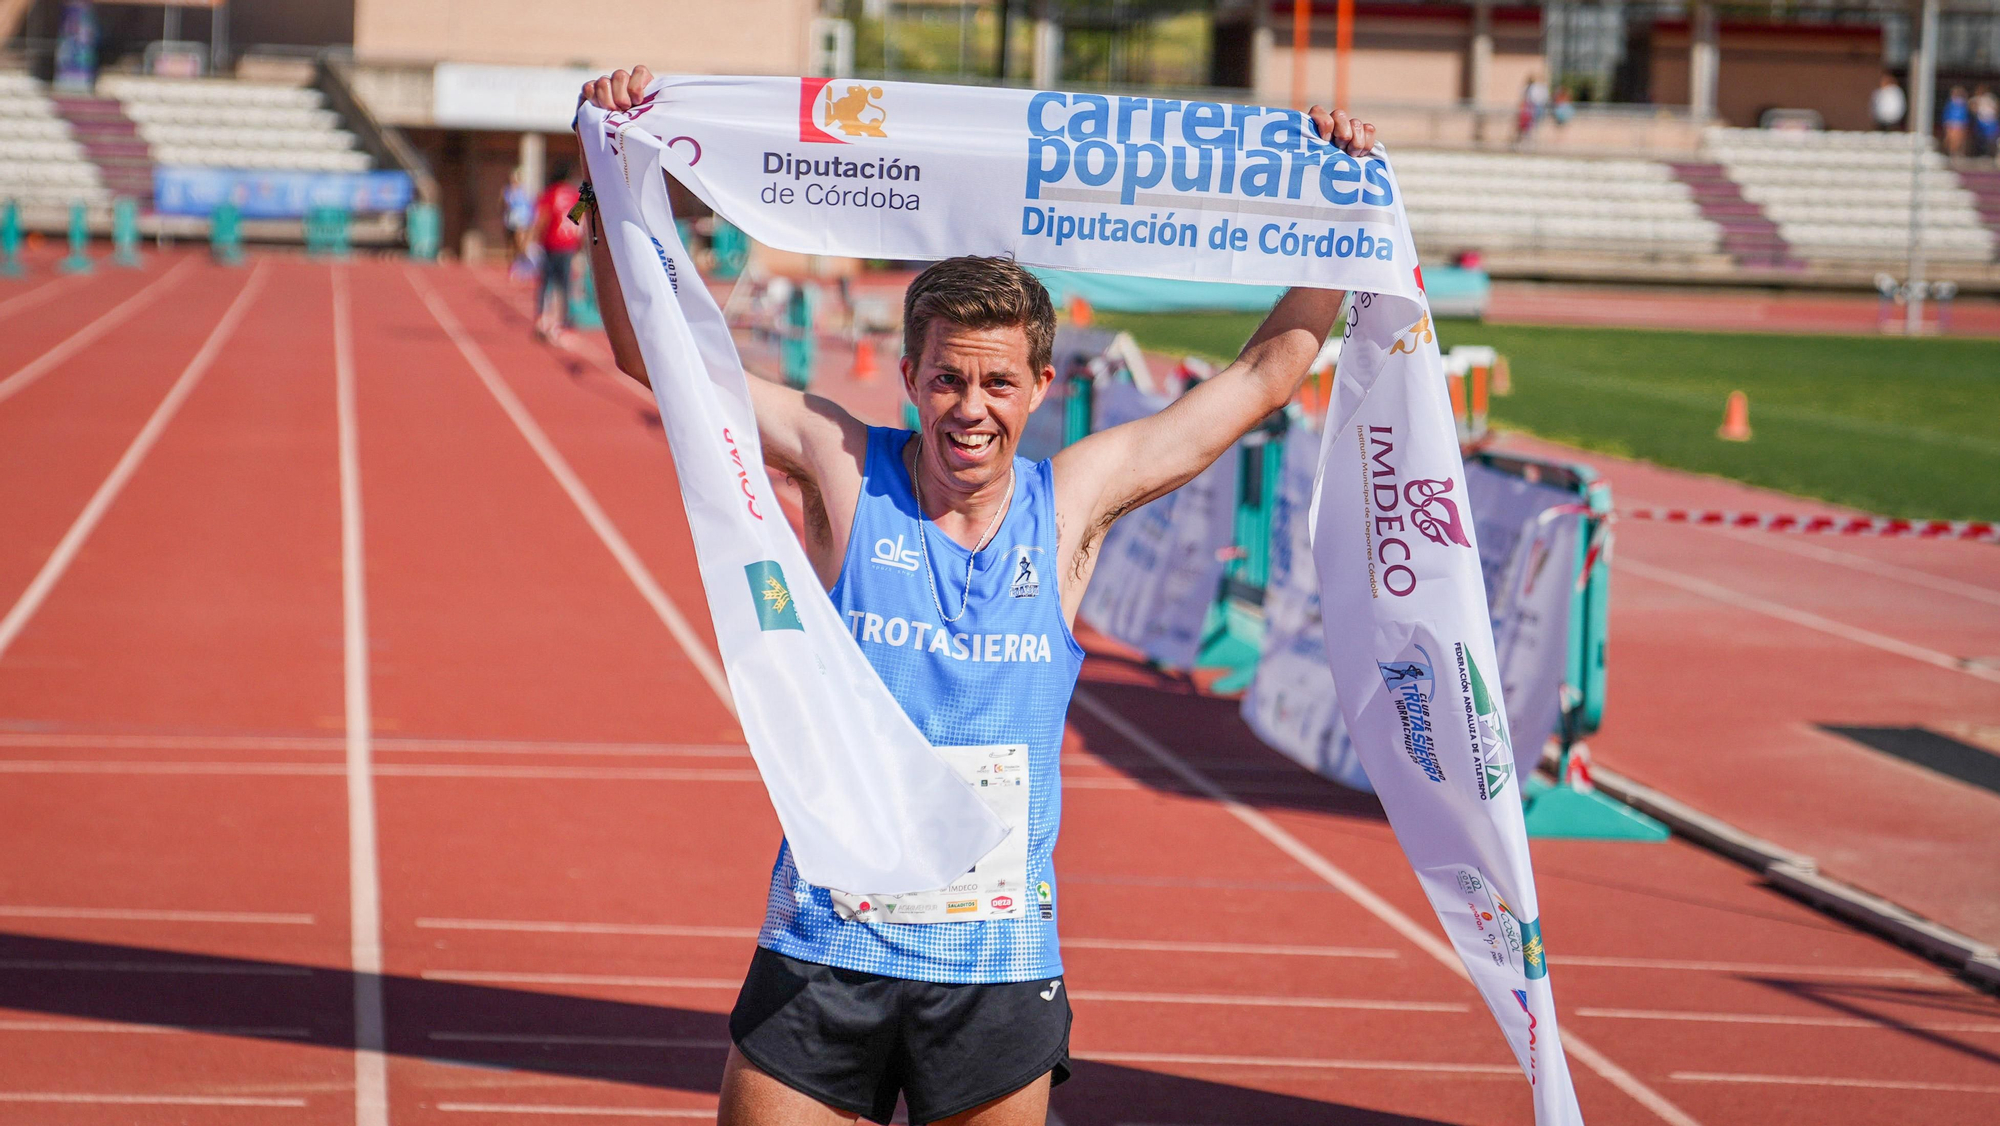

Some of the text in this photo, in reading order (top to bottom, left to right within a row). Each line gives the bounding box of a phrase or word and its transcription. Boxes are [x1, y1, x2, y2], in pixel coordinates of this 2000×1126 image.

[763, 151, 921, 181] Diputación
[1025, 128, 1394, 206] populares
[760, 182, 921, 211] de Córdoba
[1021, 206, 1394, 261] Diputación de Córdoba
[1356, 424, 1378, 599] Instituto Municipal de Deportes Córdoba
[1369, 425, 1416, 597] IMDECO
[871, 534, 920, 571] als
[848, 609, 1051, 663] TROTASIERRA
[1394, 699, 1420, 765] HORNACHUELOS
[1400, 683, 1442, 783] TROTASIERRA
[1419, 693, 1446, 781] CLUB DE ATLETISMO
[1454, 642, 1487, 800] FEDERACIÓN ANDALUZA DE ATLETISMO
[948, 883, 978, 892] IMDECO
[1460, 870, 1474, 895] COARE
